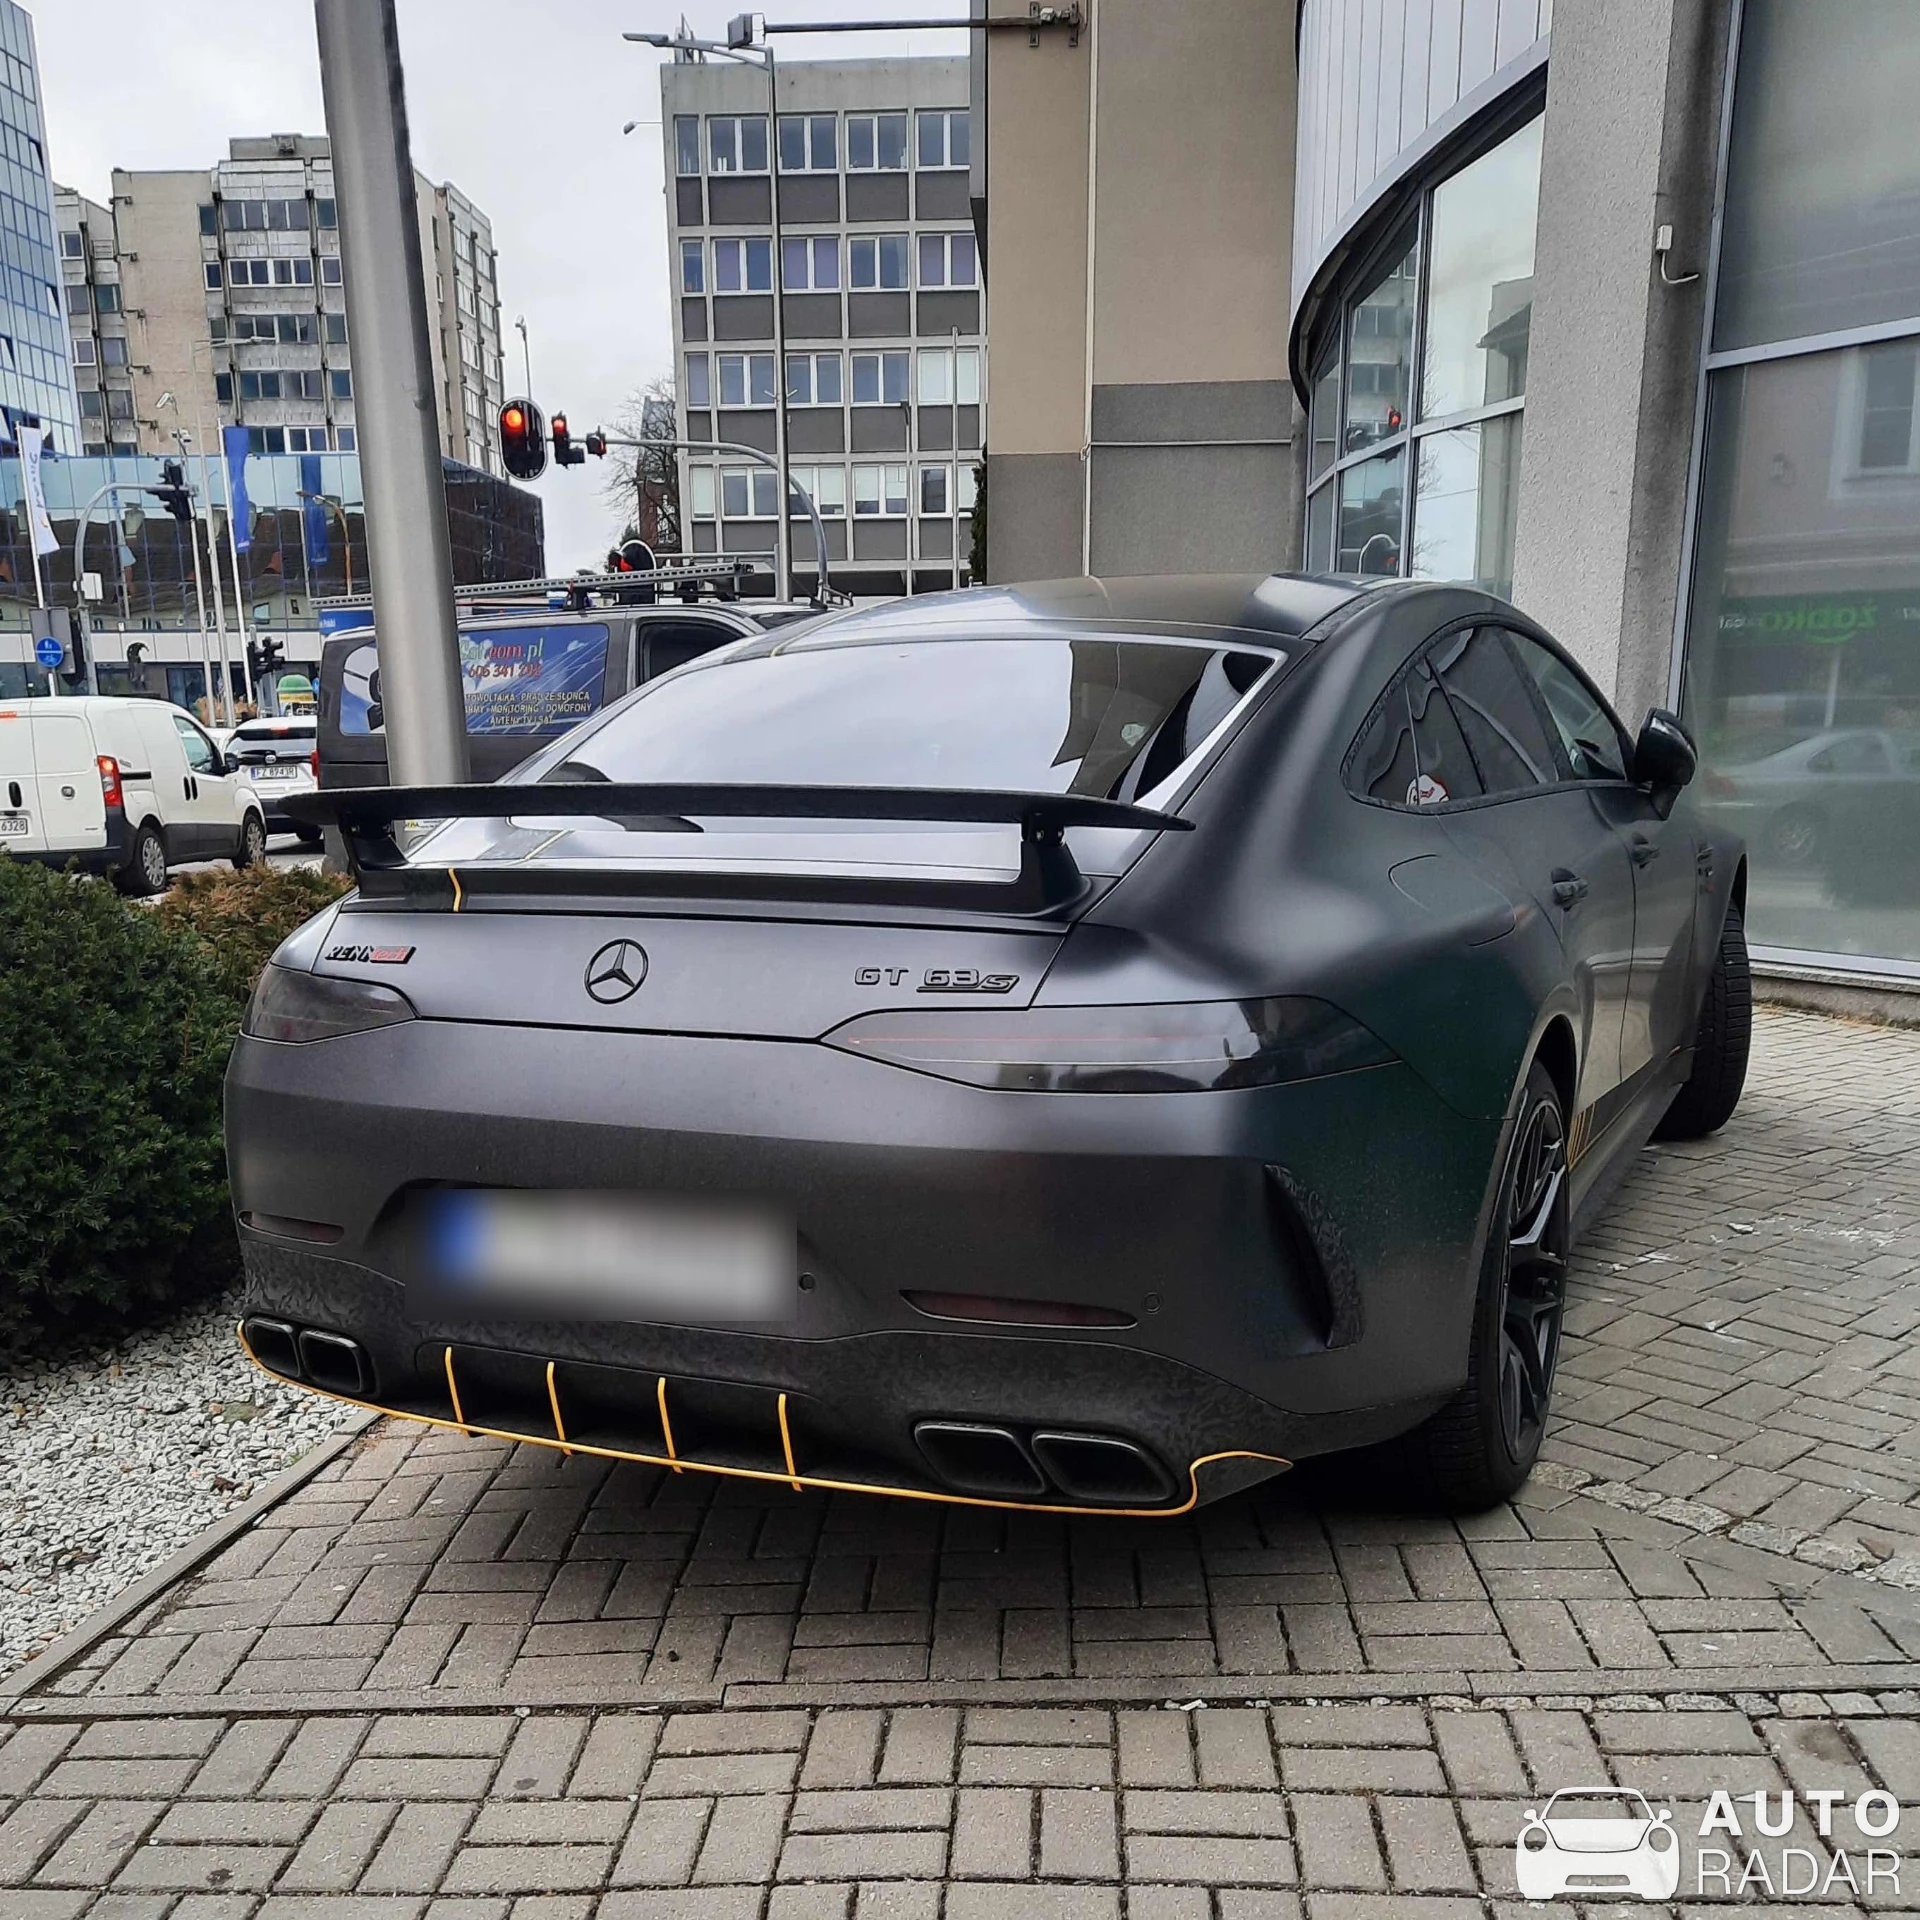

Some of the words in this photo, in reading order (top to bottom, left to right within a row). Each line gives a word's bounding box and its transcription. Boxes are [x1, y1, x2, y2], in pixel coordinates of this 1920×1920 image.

[490, 704, 539, 714] MONITORING
[546, 703, 592, 712] DOMOFONY
[1, 820, 25, 831] 6328
[854, 966, 909, 986] GT
